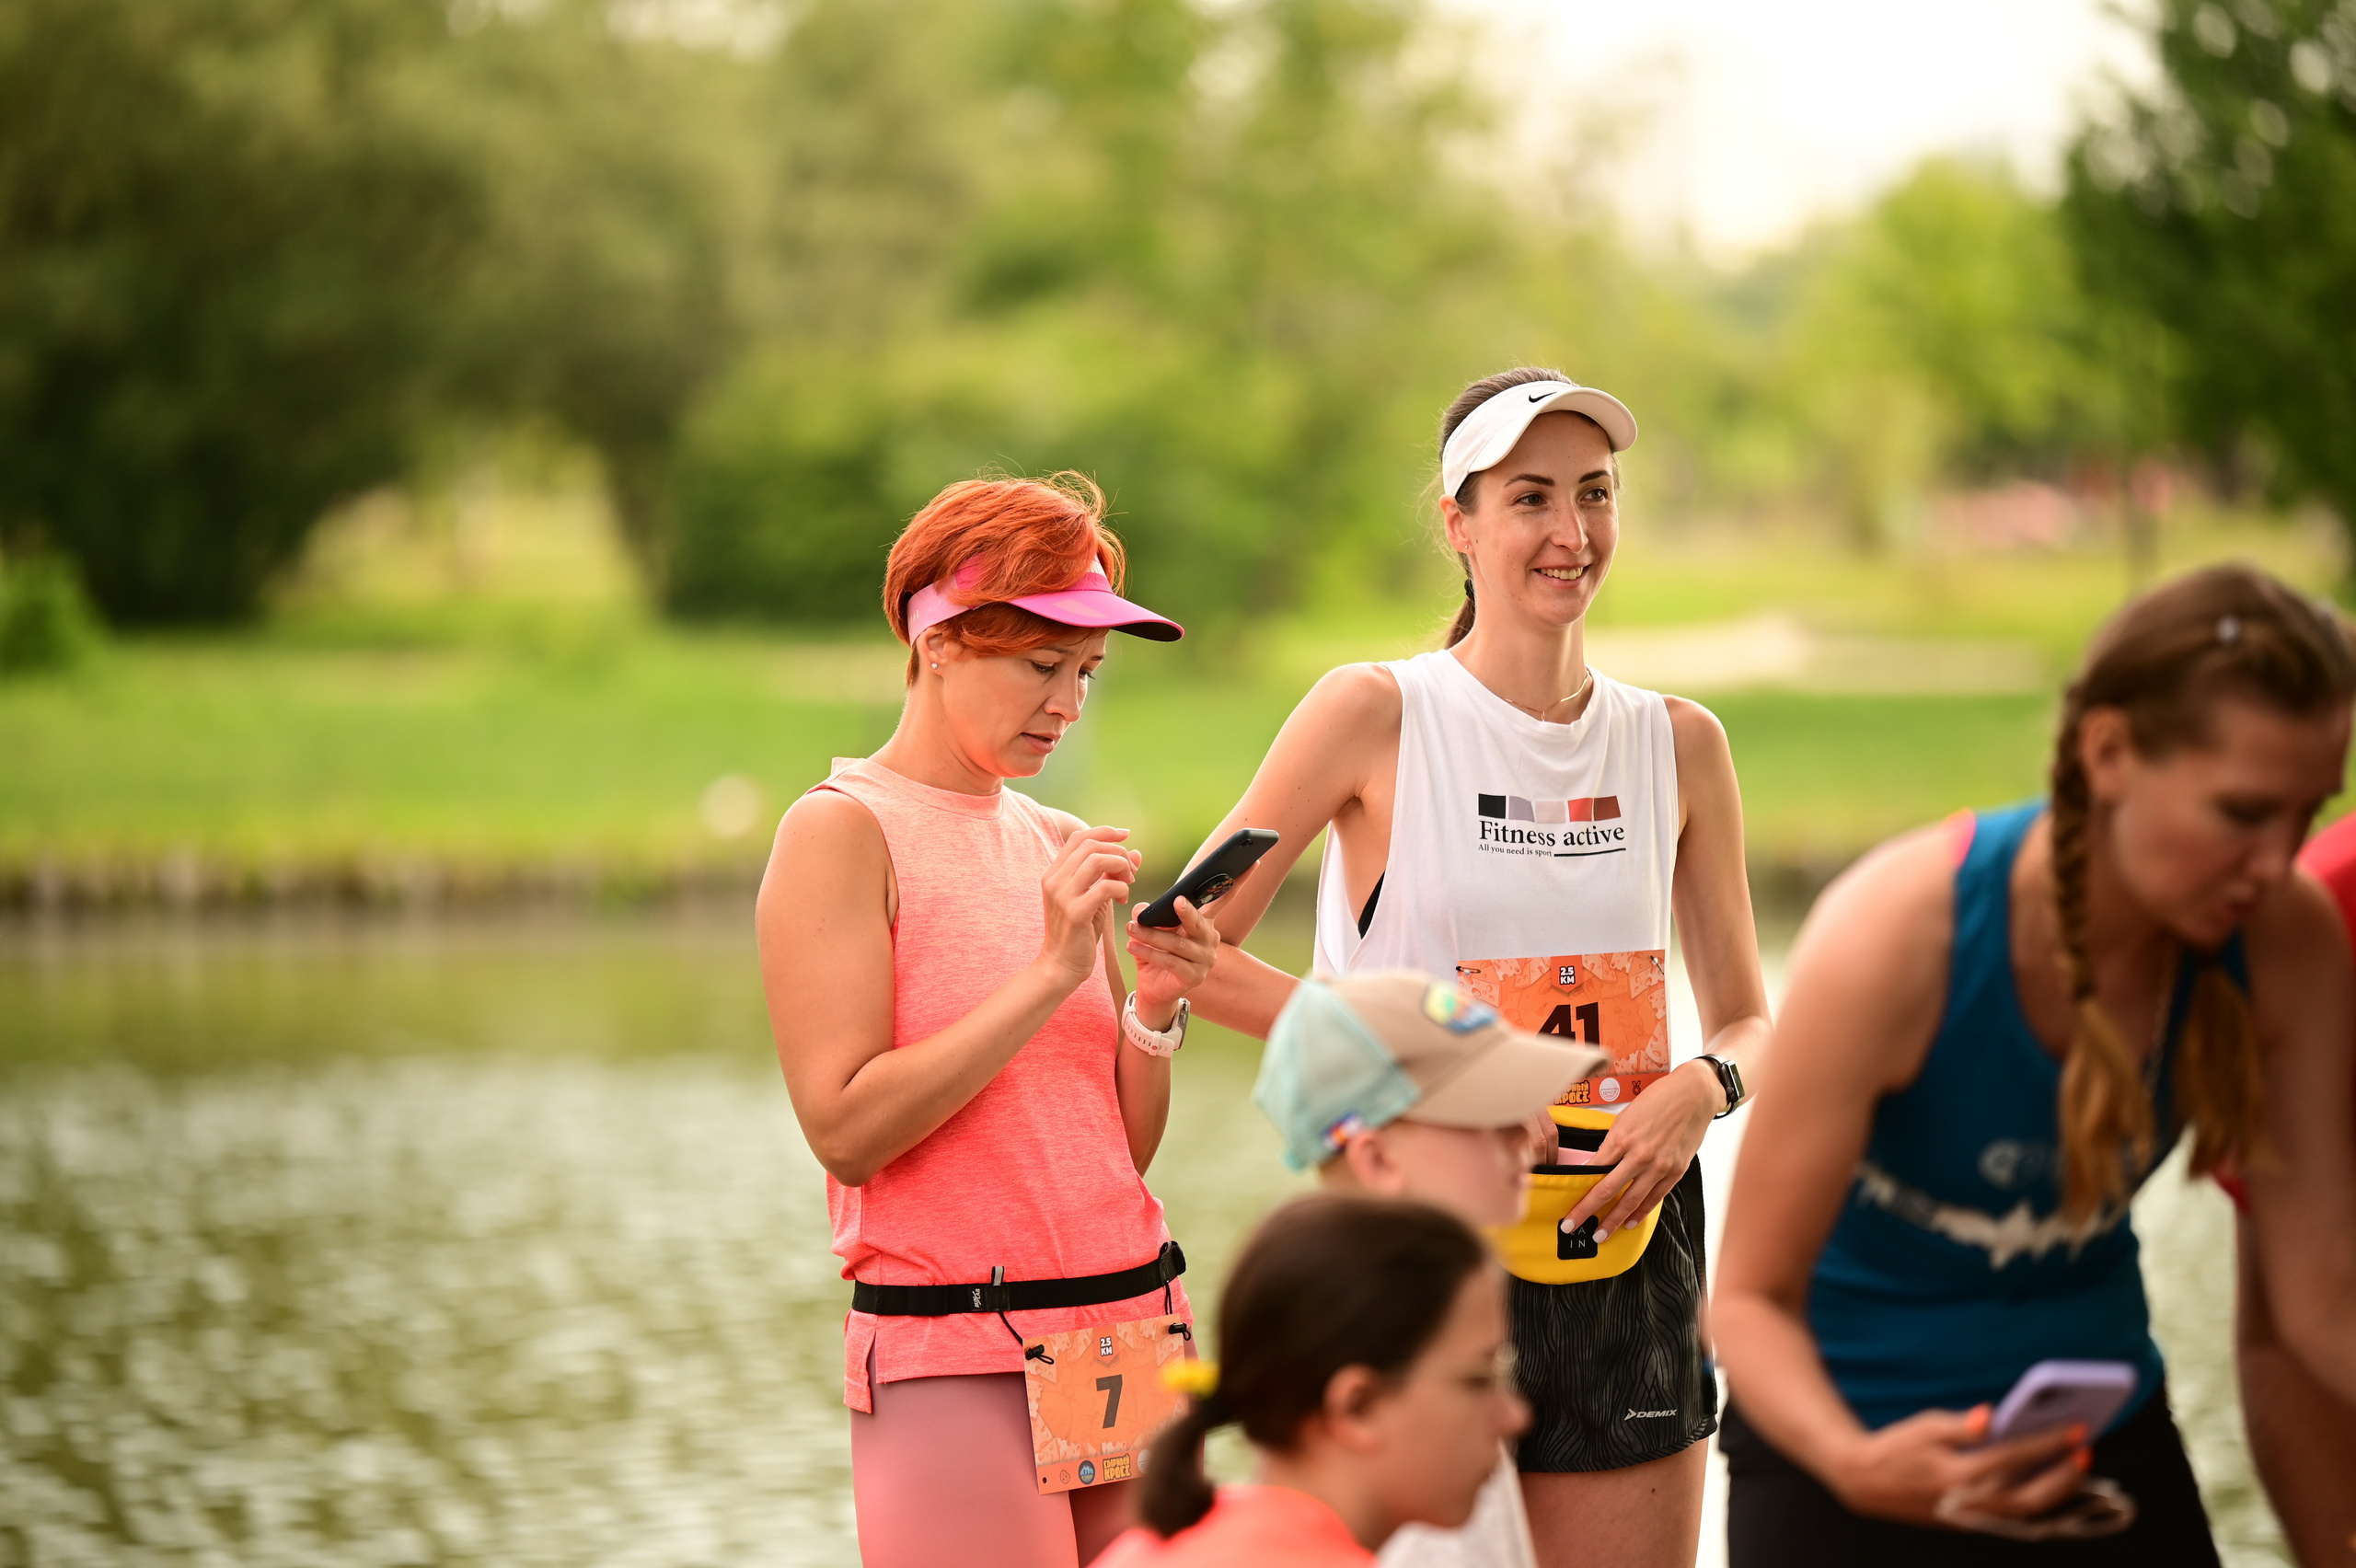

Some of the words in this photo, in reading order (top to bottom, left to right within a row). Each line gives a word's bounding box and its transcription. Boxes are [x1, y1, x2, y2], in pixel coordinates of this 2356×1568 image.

[1479, 820, 1556, 847] Fitness
[1563, 825, 1625, 846] active
[1491, 846, 1505, 854] you
[1534, 849, 1553, 858] sport
[1560, 966, 1575, 976] 2.5
[1537, 1001, 1600, 1050] 41
[1100, 1337, 1112, 1347] 2.5
[1095, 1374, 1123, 1429] 7
[1636, 1409, 1678, 1418] DEMIX
